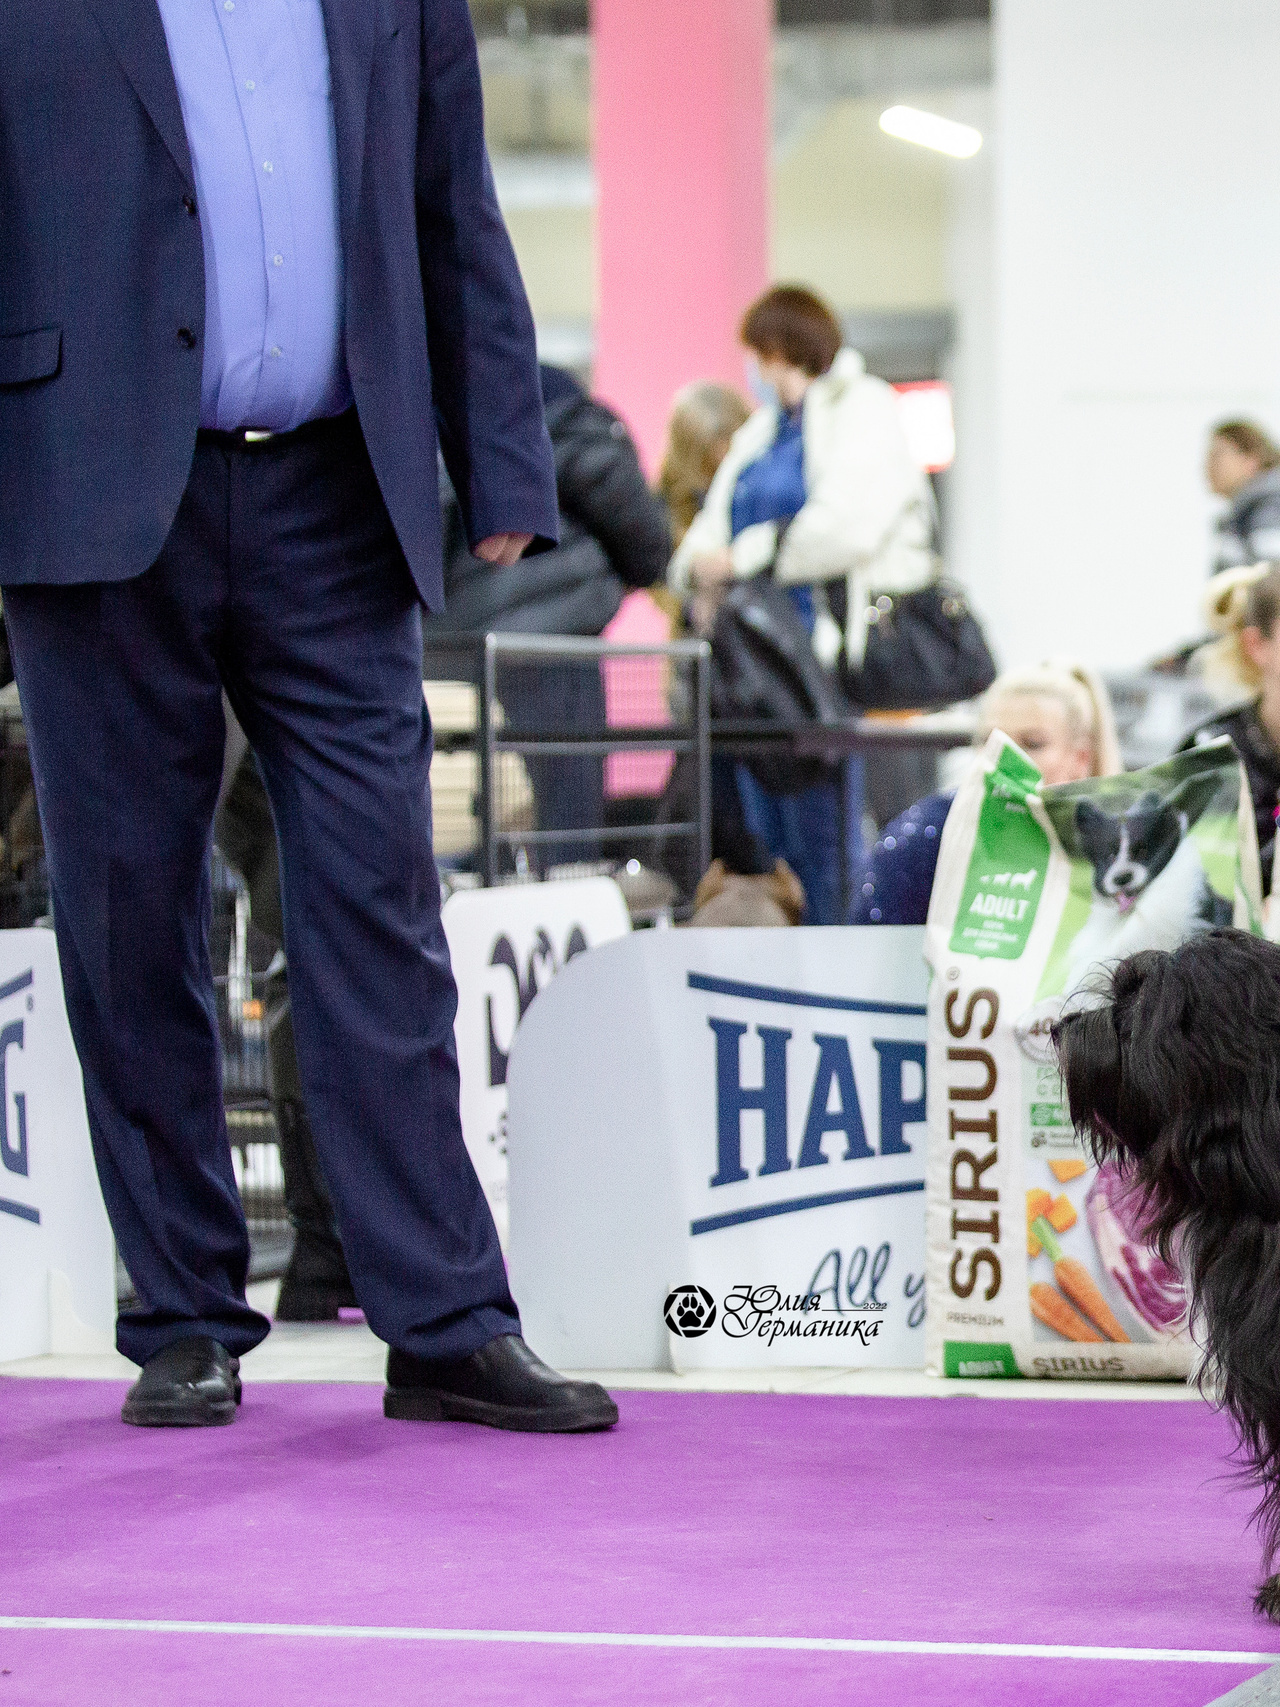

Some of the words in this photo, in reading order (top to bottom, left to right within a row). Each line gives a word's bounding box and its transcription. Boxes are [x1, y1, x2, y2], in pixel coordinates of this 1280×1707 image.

[969, 891, 1030, 921] ADULT
[946, 986, 1001, 1301] SIRIUS
[803, 1241, 892, 1315] All
[947, 1312, 1004, 1327] PREMIUM
[1032, 1357, 1126, 1373] SIRIUS
